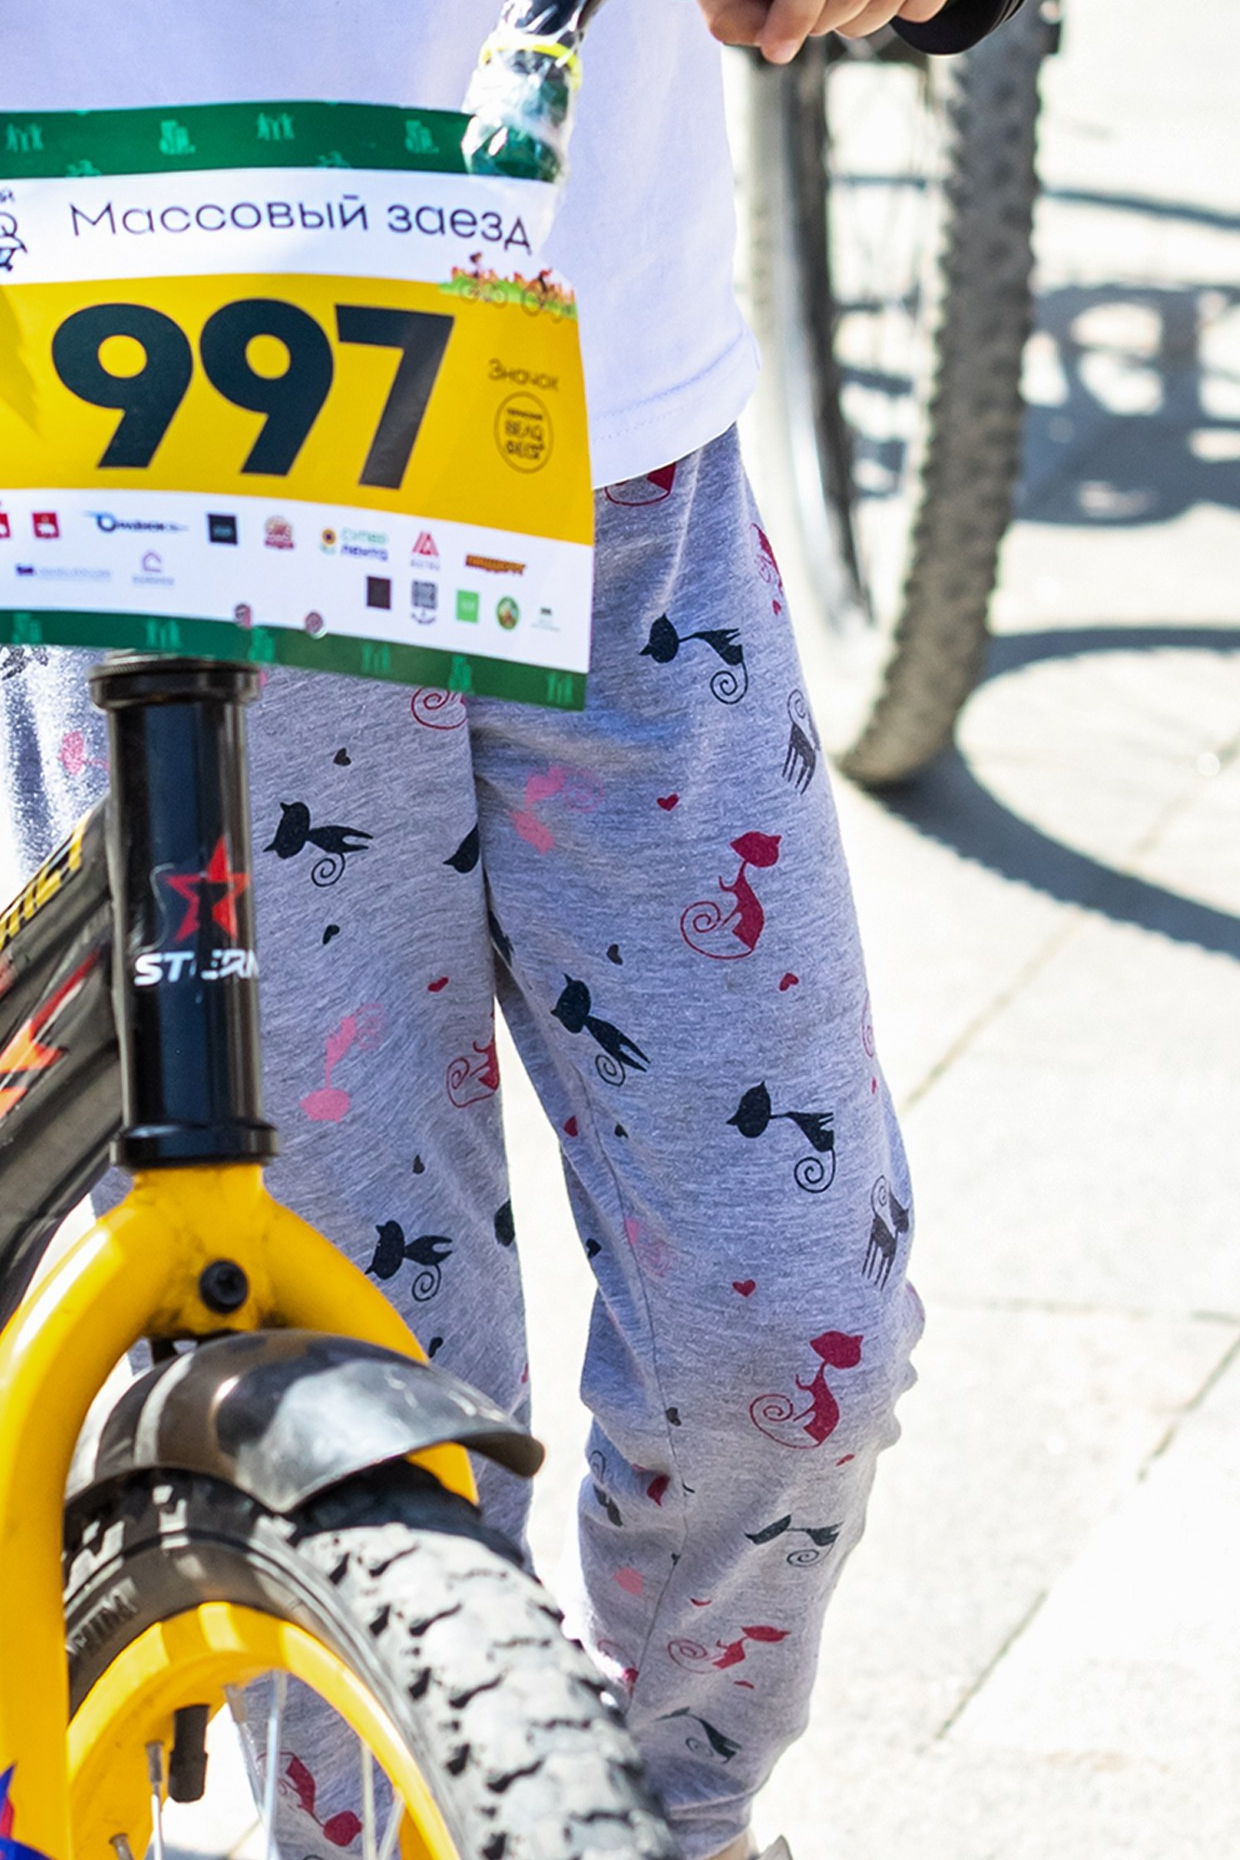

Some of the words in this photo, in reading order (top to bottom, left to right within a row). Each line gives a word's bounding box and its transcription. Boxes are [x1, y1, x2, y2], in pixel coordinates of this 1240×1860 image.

[70, 194, 368, 237] Массовый
[387, 204, 532, 255] заезд
[51, 298, 455, 490] 997
